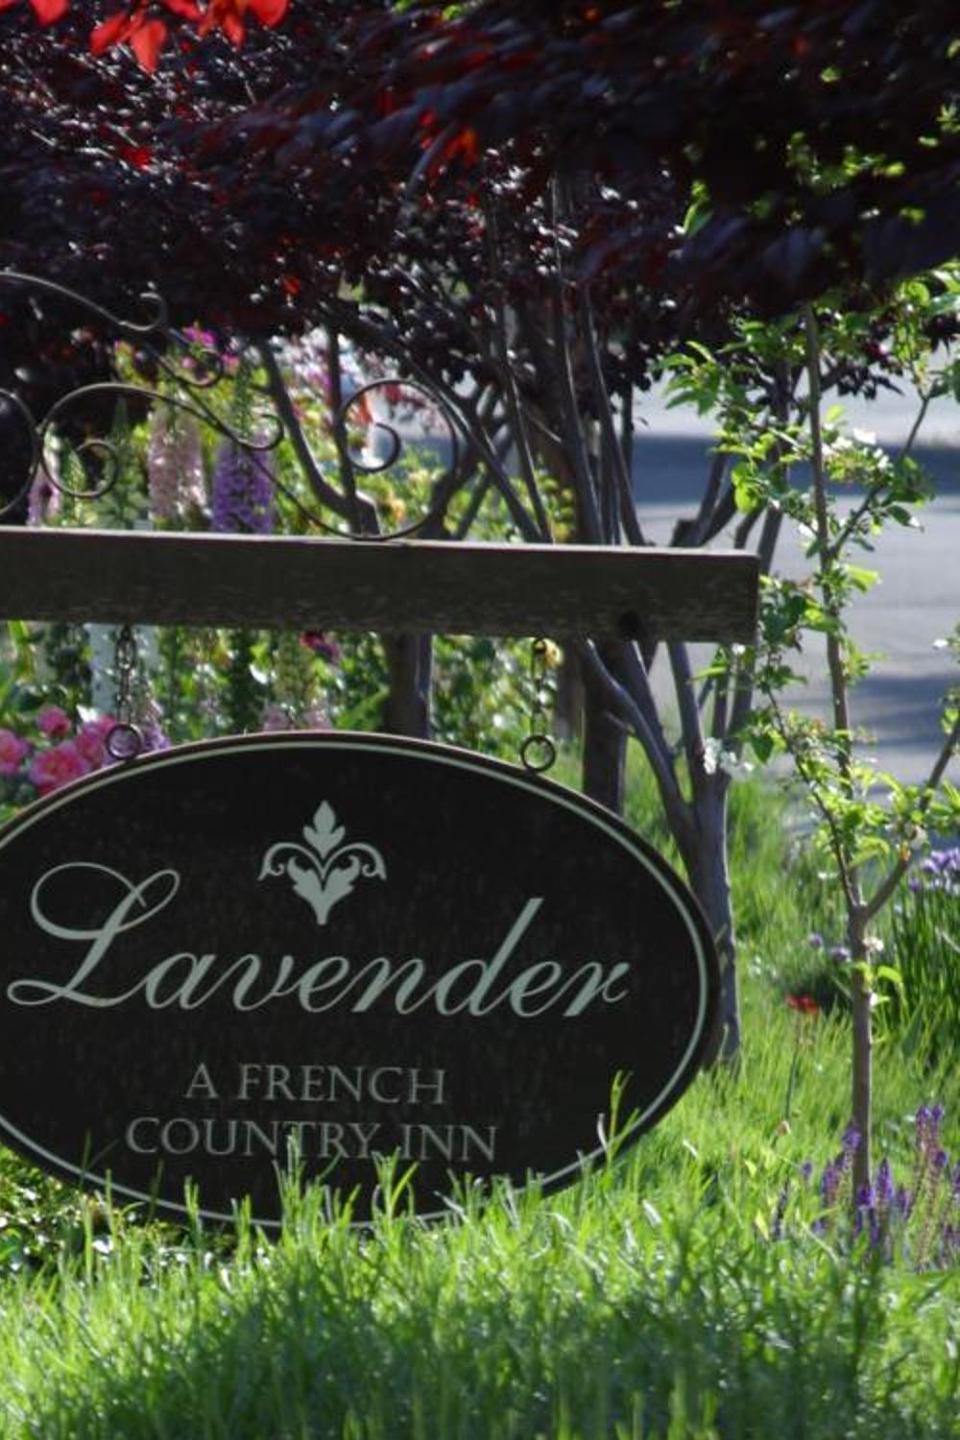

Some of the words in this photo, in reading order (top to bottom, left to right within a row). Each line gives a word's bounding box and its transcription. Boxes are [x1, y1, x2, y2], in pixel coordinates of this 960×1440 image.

[6, 861, 631, 1018] Lavender
[185, 1062, 219, 1099] A
[238, 1063, 446, 1105] FRENCH
[126, 1117, 382, 1159] COUNTRY
[402, 1122, 498, 1162] INN
